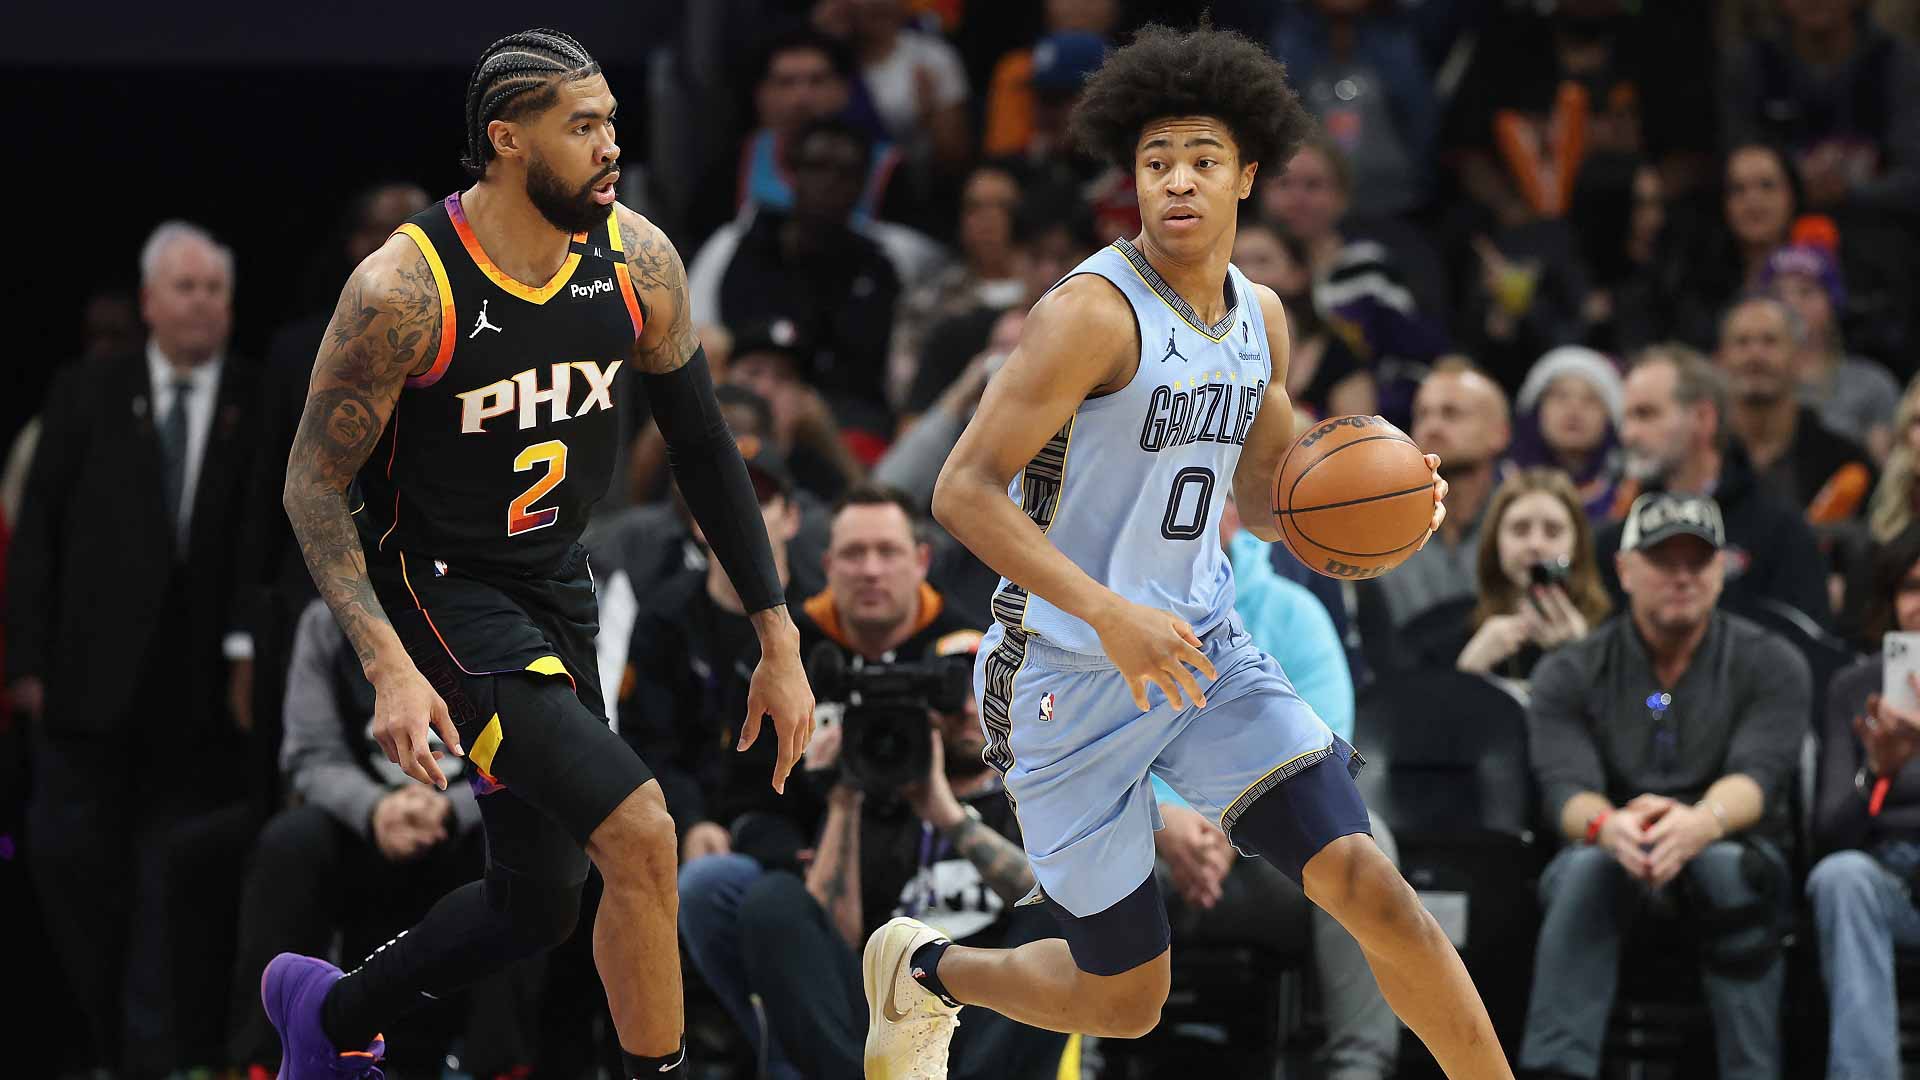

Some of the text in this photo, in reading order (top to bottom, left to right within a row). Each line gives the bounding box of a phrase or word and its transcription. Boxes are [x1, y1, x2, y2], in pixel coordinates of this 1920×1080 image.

[593, 247, 603, 258] AL
[570, 277, 615, 299] PayPal
[455, 360, 624, 434] PHX
[1172, 370, 1259, 391] MEMPHS
[507, 439, 568, 537] 2
[1160, 466, 1216, 541] 0
